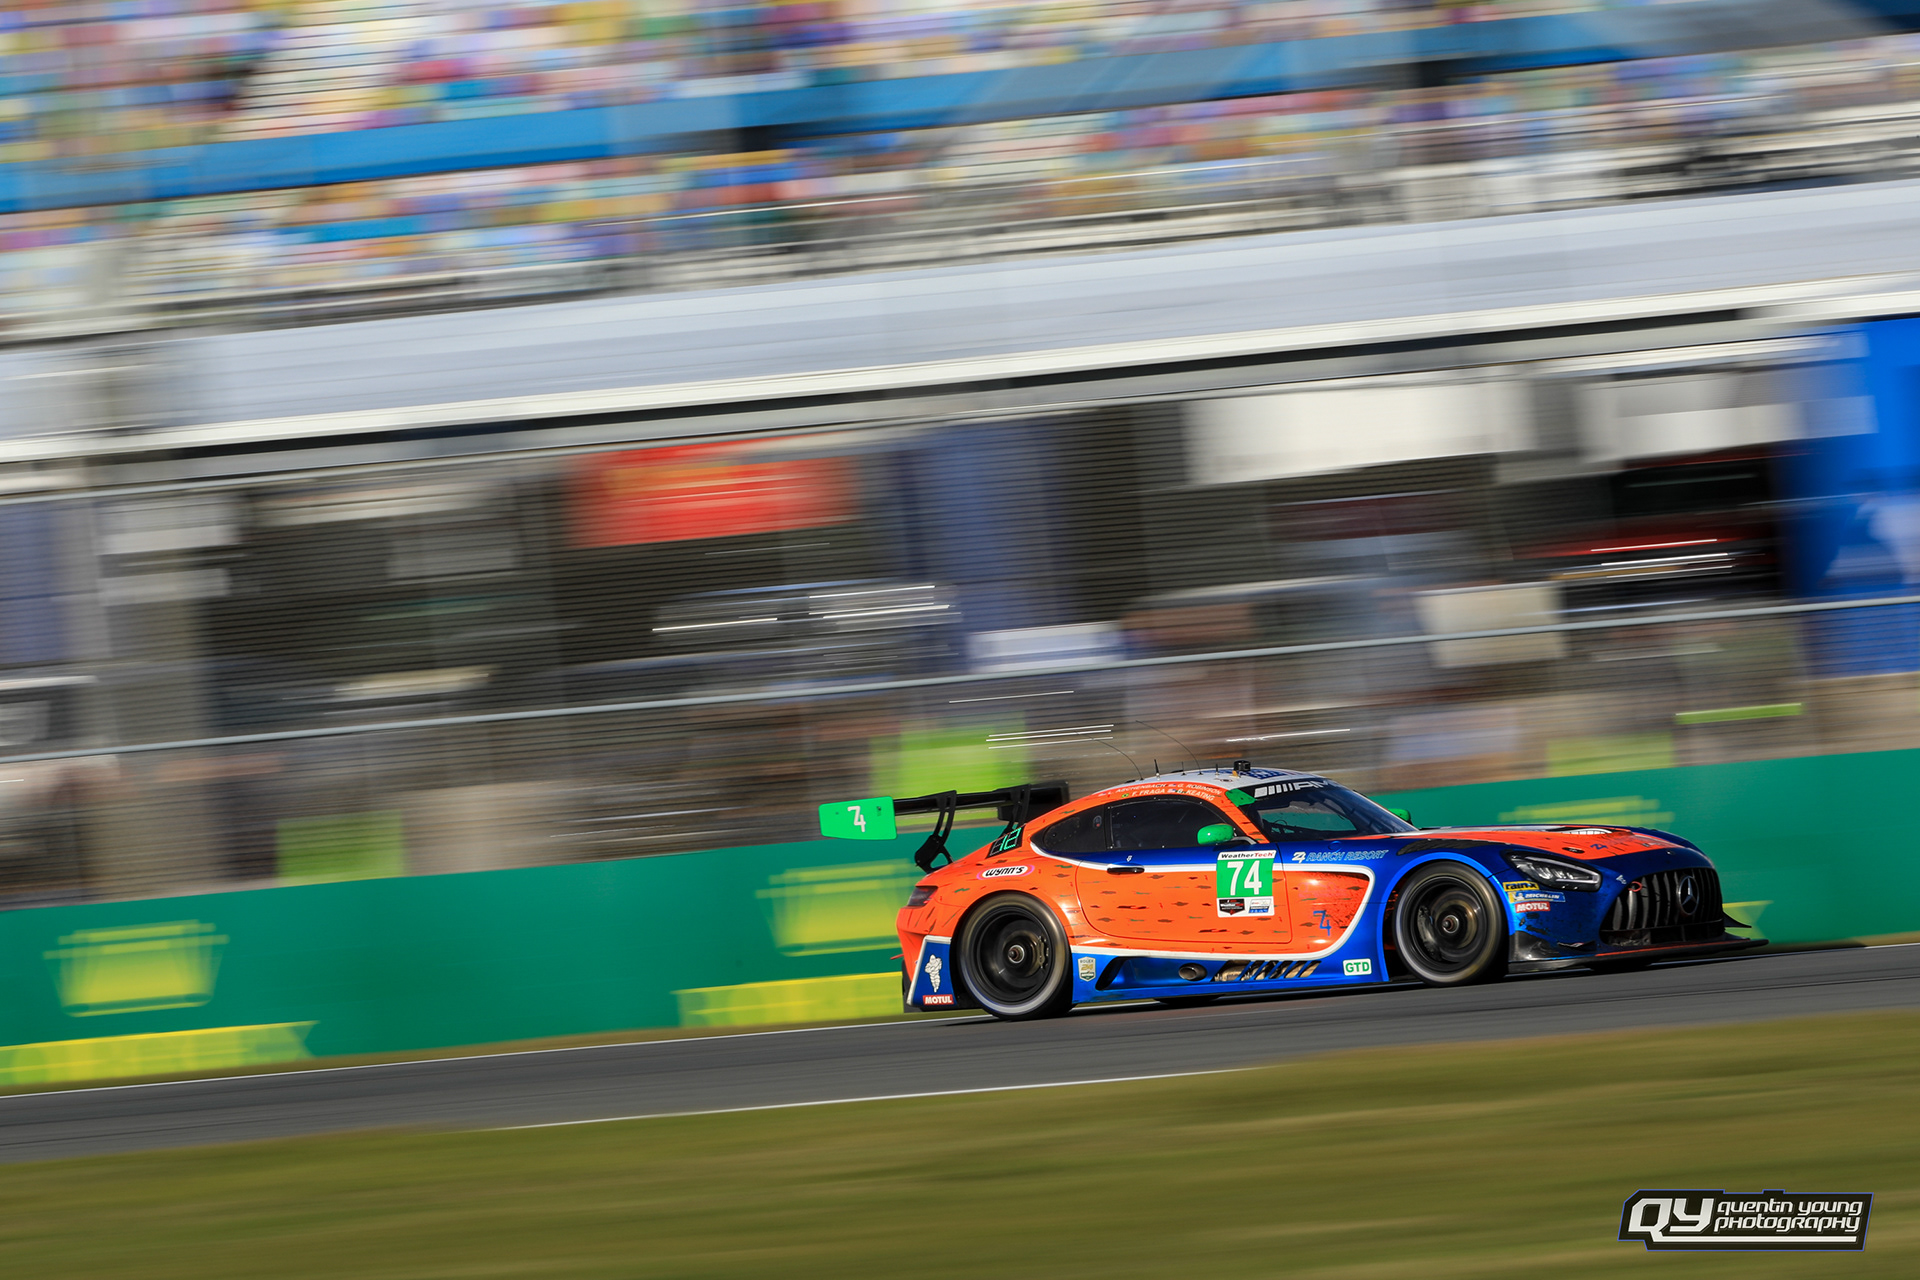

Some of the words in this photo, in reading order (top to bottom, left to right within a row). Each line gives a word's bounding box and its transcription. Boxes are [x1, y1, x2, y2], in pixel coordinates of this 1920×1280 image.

[1139, 788, 1166, 796] FRAGA
[1186, 789, 1216, 801] KEATING
[847, 805, 866, 833] 74
[1306, 852, 1345, 861] RANCH
[1344, 849, 1389, 860] RESORT
[1227, 860, 1262, 896] 74
[1516, 902, 1549, 912] MOTUL
[1313, 910, 1332, 936] 74
[1345, 961, 1370, 973] GTD
[925, 995, 952, 1005] MOTUL
